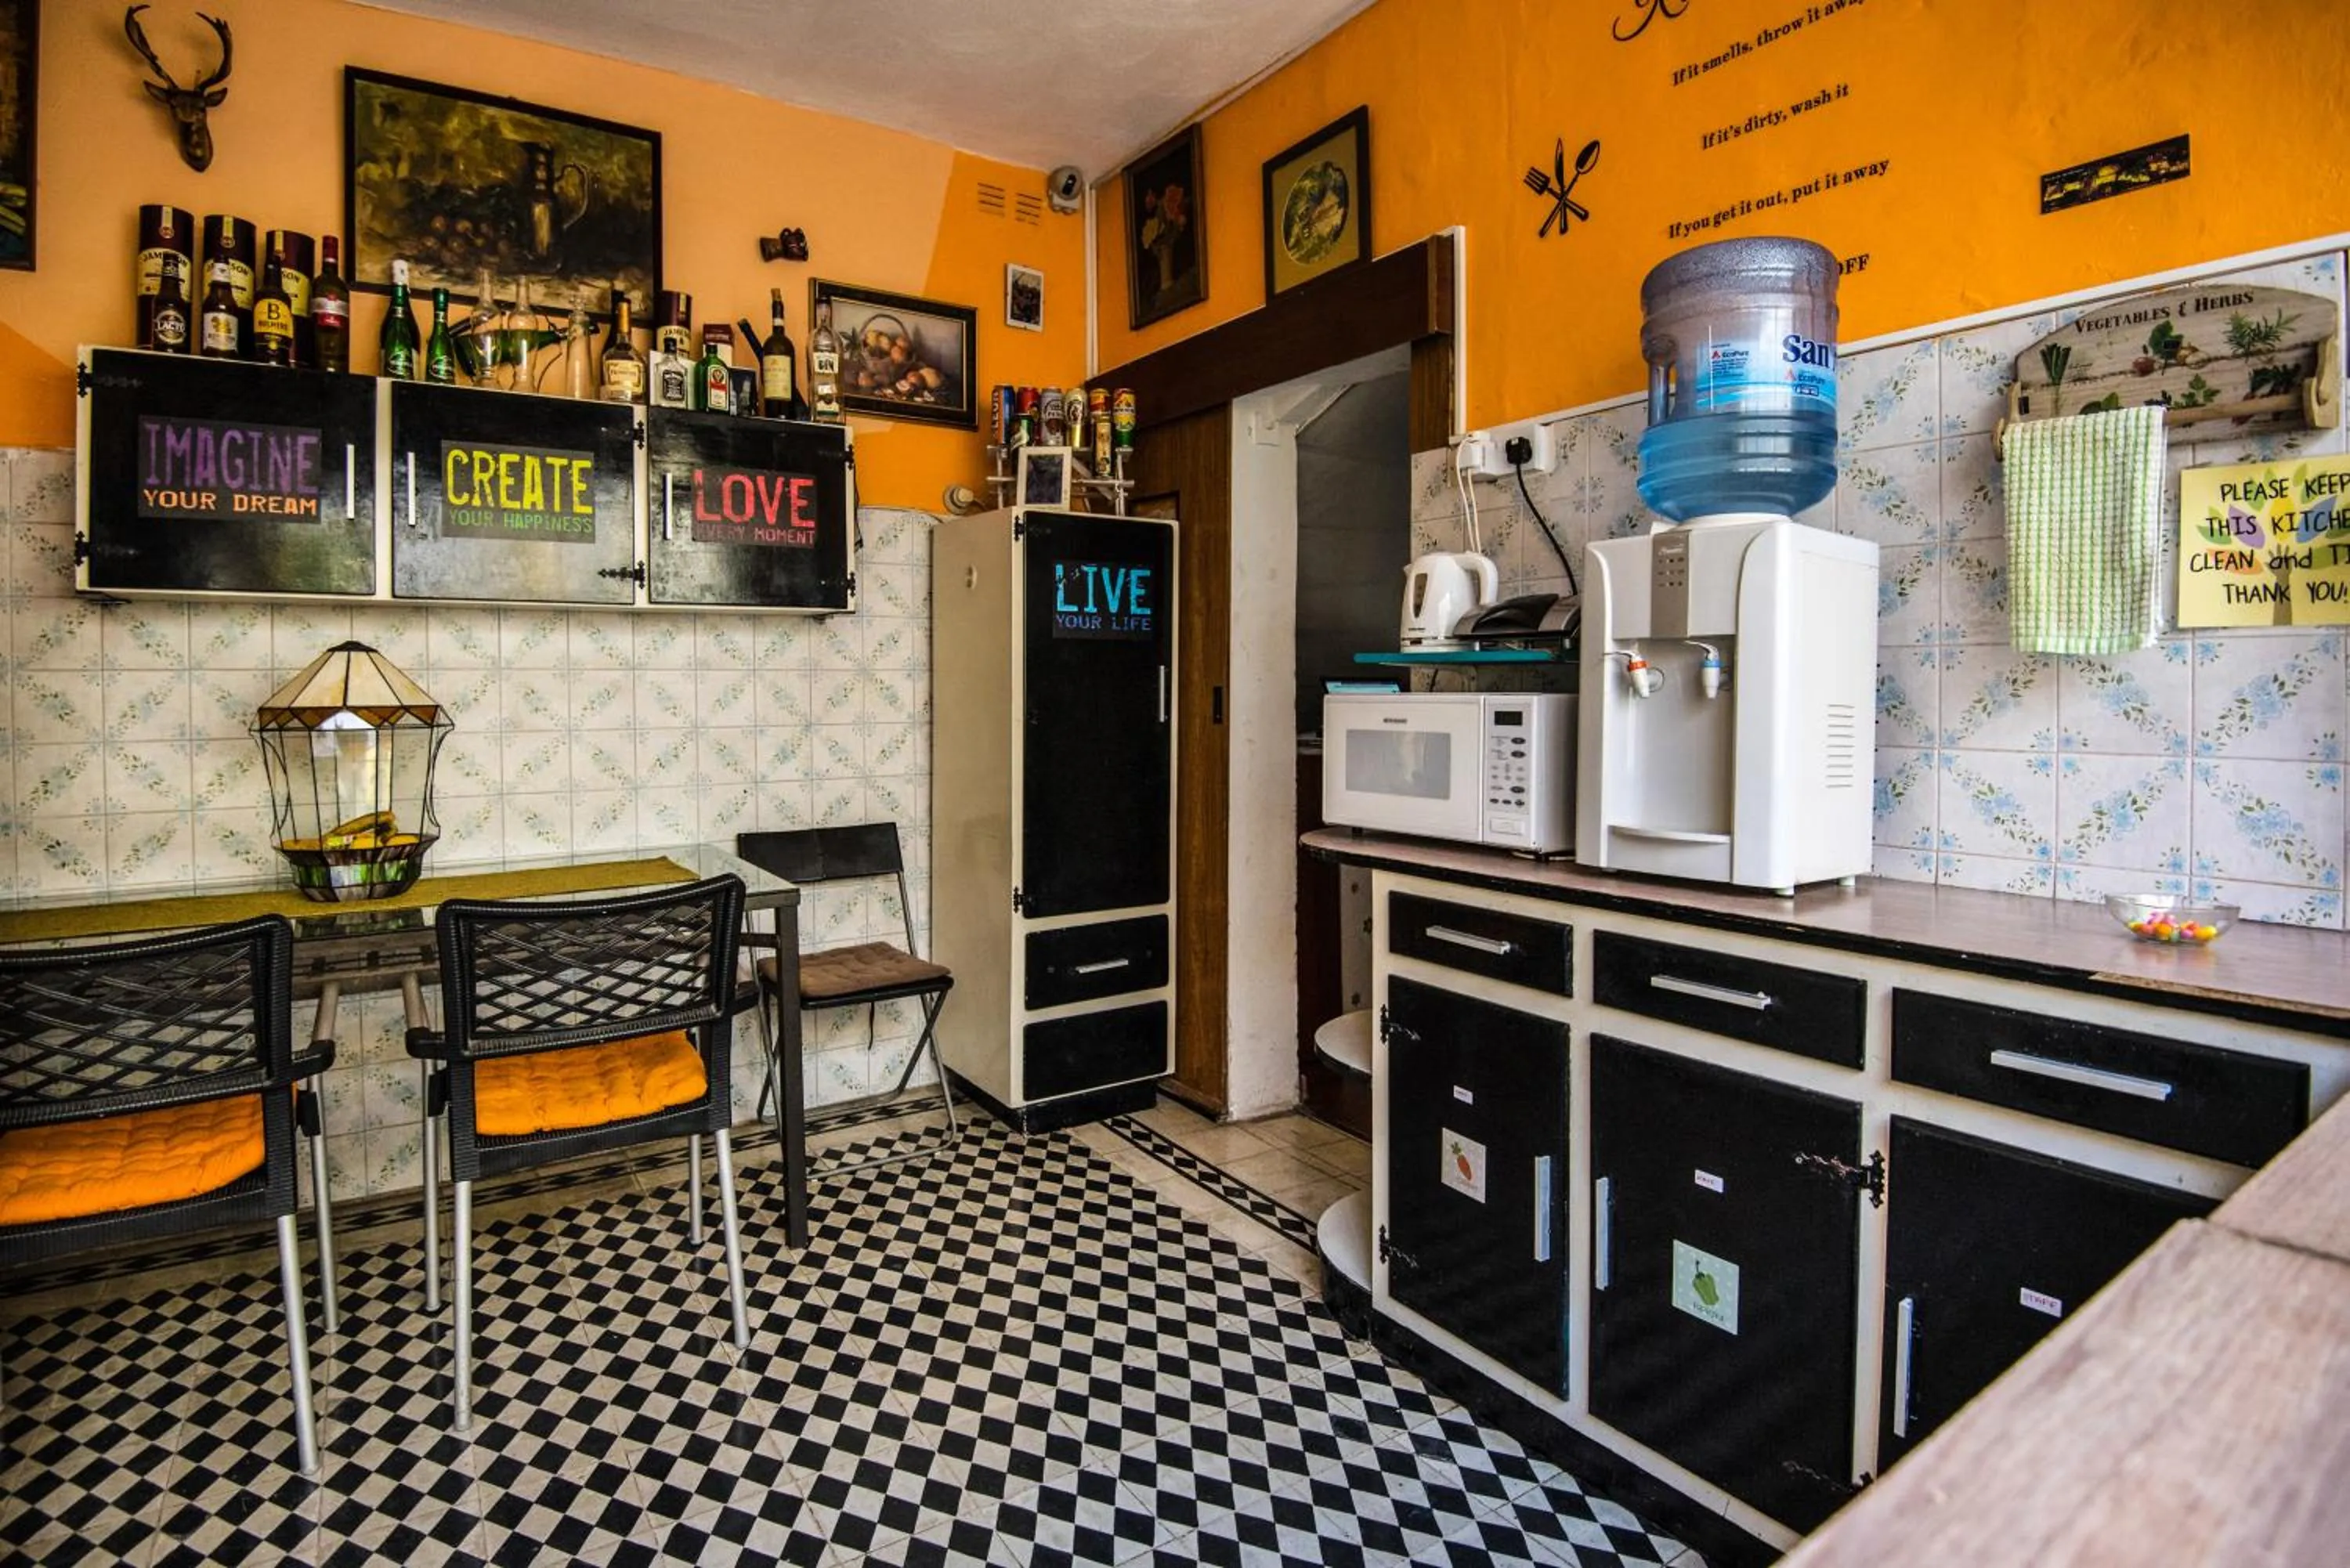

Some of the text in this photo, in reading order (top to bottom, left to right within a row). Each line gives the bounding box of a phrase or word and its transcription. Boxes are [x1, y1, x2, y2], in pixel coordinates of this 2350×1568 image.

[1672, 68, 1687, 86] If
[1688, 63, 1699, 80] it
[1756, 17, 1803, 47] throw
[1807, 8, 1820, 24] it
[1701, 83, 1849, 150] If it's dirty, wash it
[1668, 224, 1683, 239] If
[1683, 216, 1710, 237] you
[1713, 206, 1737, 228] get
[1740, 201, 1752, 217] it
[1791, 179, 1820, 204] put
[1824, 173, 1839, 190] it
[1842, 159, 1889, 185] away
[1782, 334, 1830, 369] San
[143, 423, 319, 493] IMAGINE
[446, 449, 593, 515] CREATE
[2220, 473, 2350, 502] PLEASE KEEP
[143, 489, 317, 515] YOUR DREAM
[693, 469, 815, 528] LOVE
[449, 510, 593, 533] YOUR HAPPINESS
[754, 528, 815, 545] MOMENT
[2206, 515, 2257, 537] THIS
[2189, 549, 2254, 573] CLEAN
[2268, 547, 2313, 570] and
[1055, 563, 1152, 615] LIVE
[2222, 580, 2348, 605] THANK YOU!
[1055, 614, 1152, 631] YOUR LIFE
